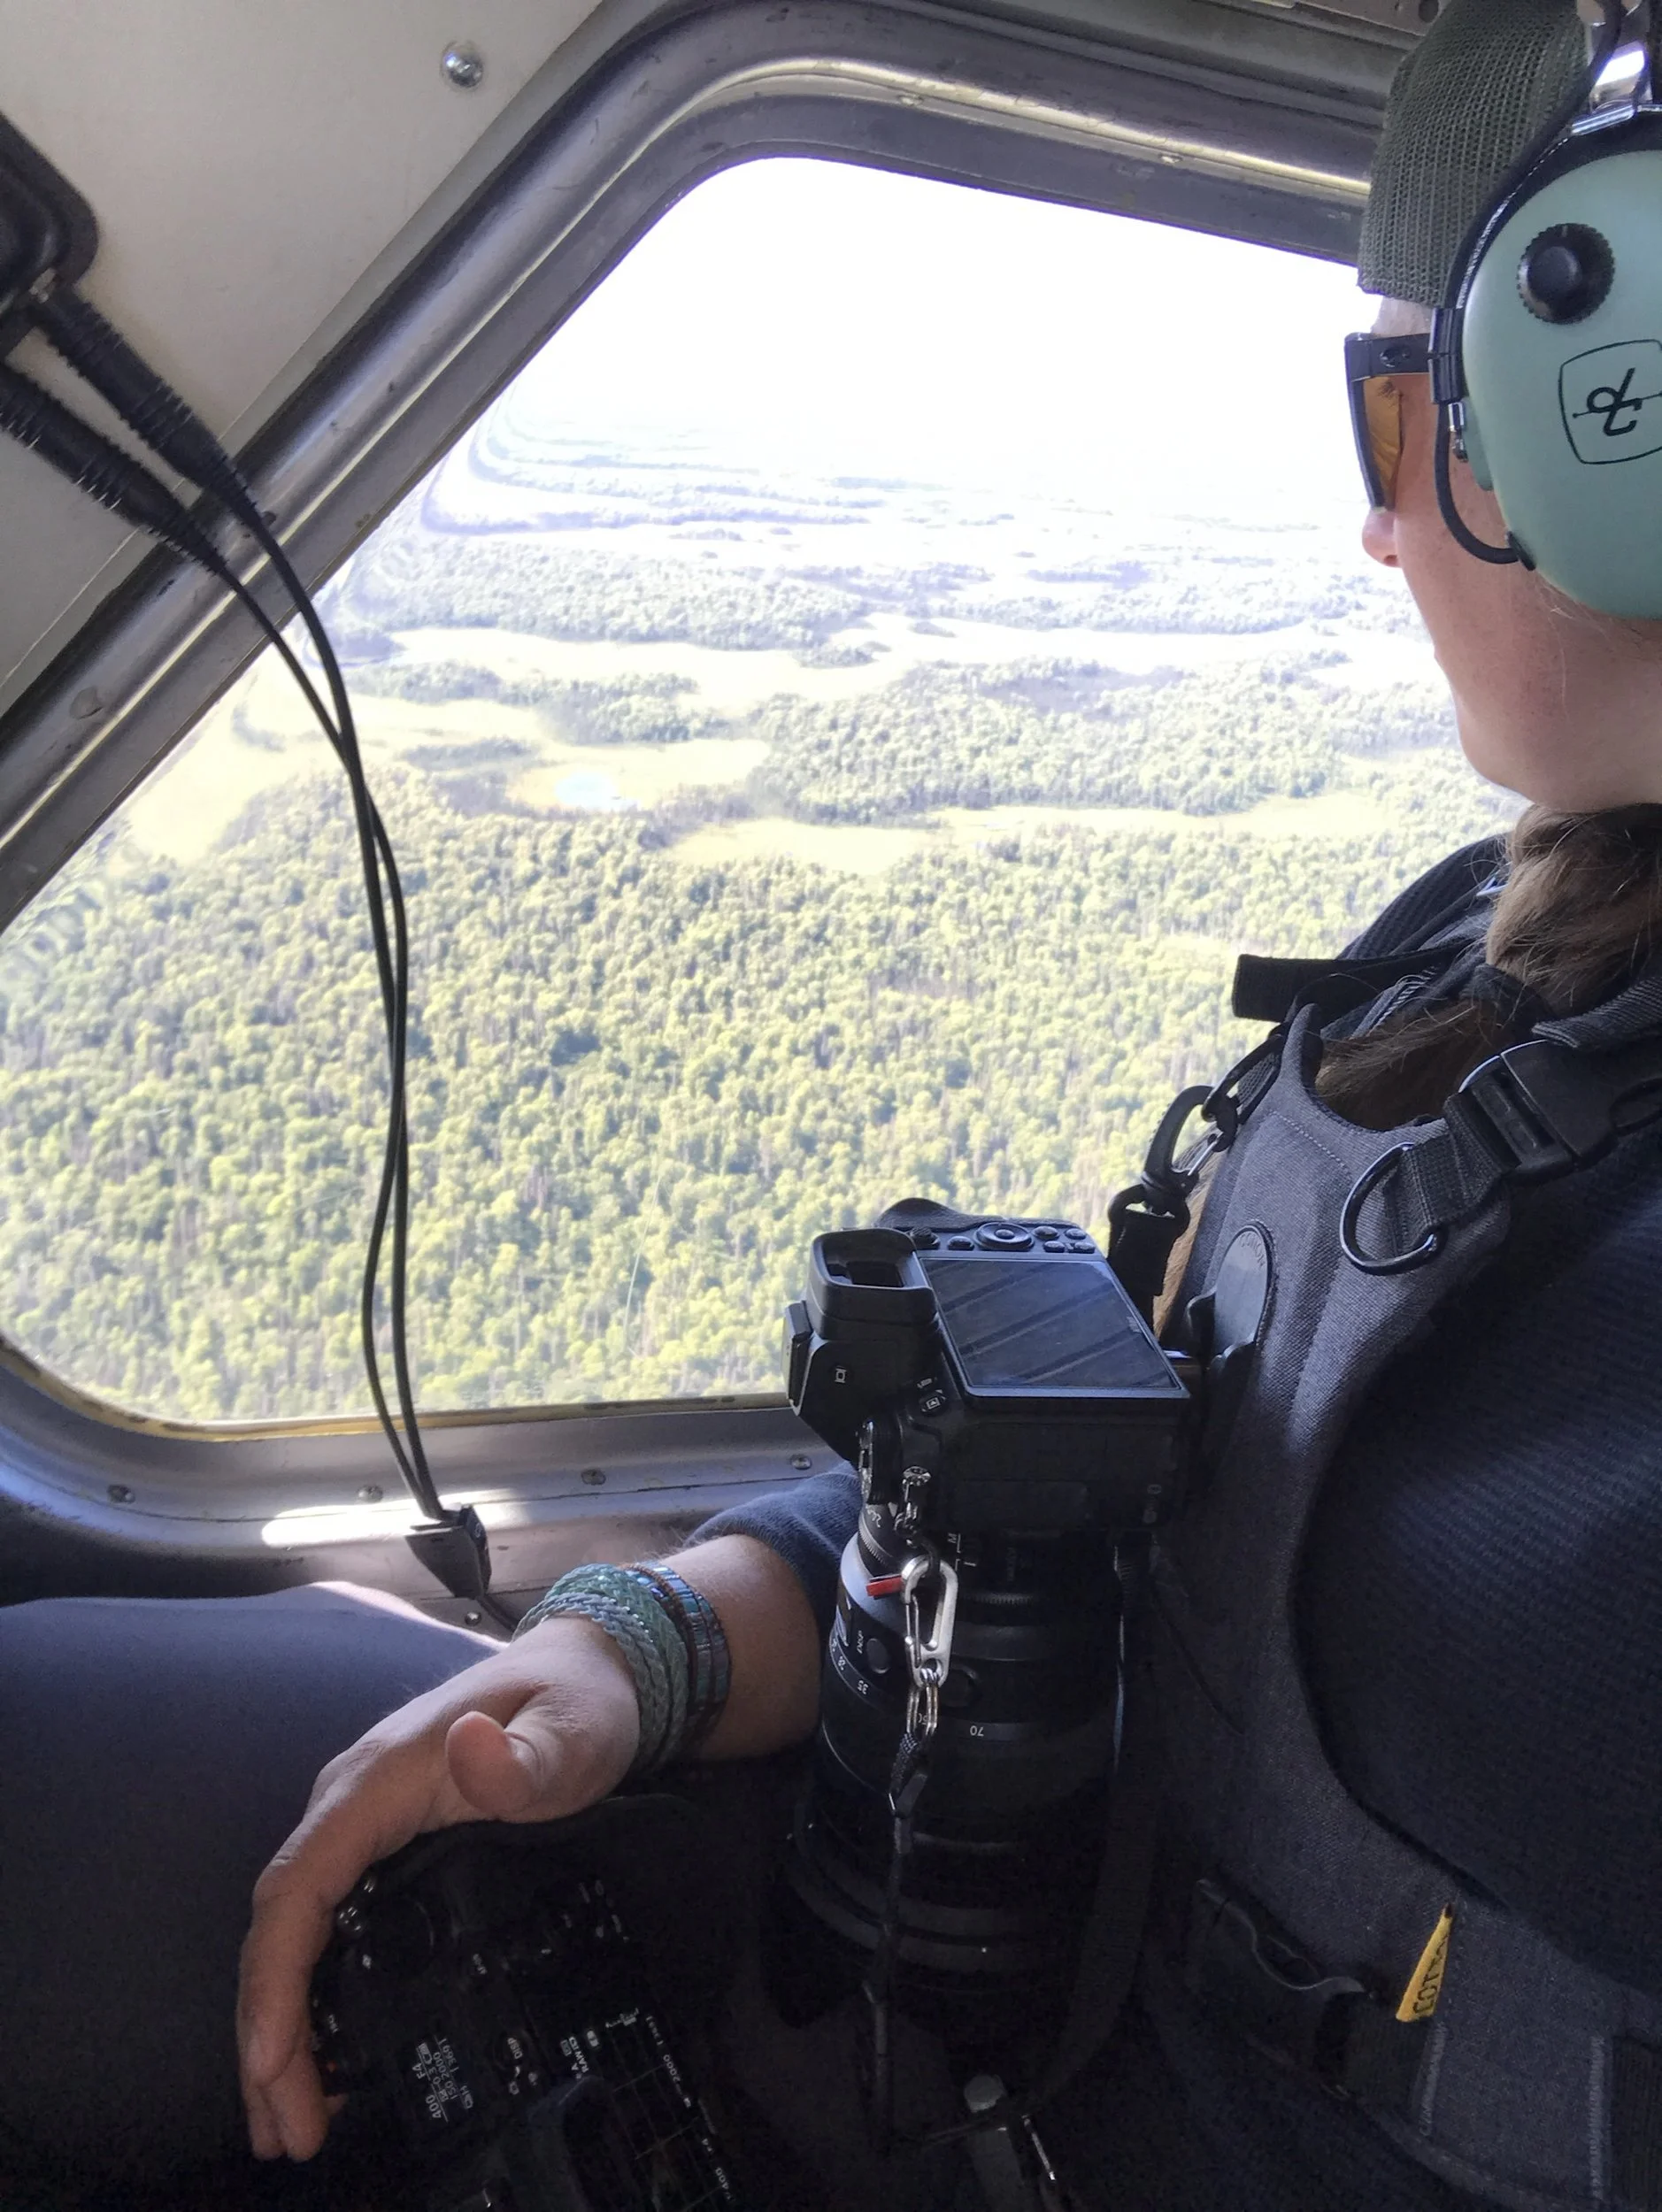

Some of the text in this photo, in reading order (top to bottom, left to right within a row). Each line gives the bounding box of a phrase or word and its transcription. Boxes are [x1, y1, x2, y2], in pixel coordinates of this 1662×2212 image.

[857, 1679, 870, 1695] 35
[969, 1724, 984, 1736] 70
[507, 2037, 523, 2060] DISP
[574, 2050, 589, 2073] RAW
[662, 2054, 681, 2083] 2000
[430, 2051, 458, 2100] ISO 2000
[412, 2062, 442, 2118] 400 F4
